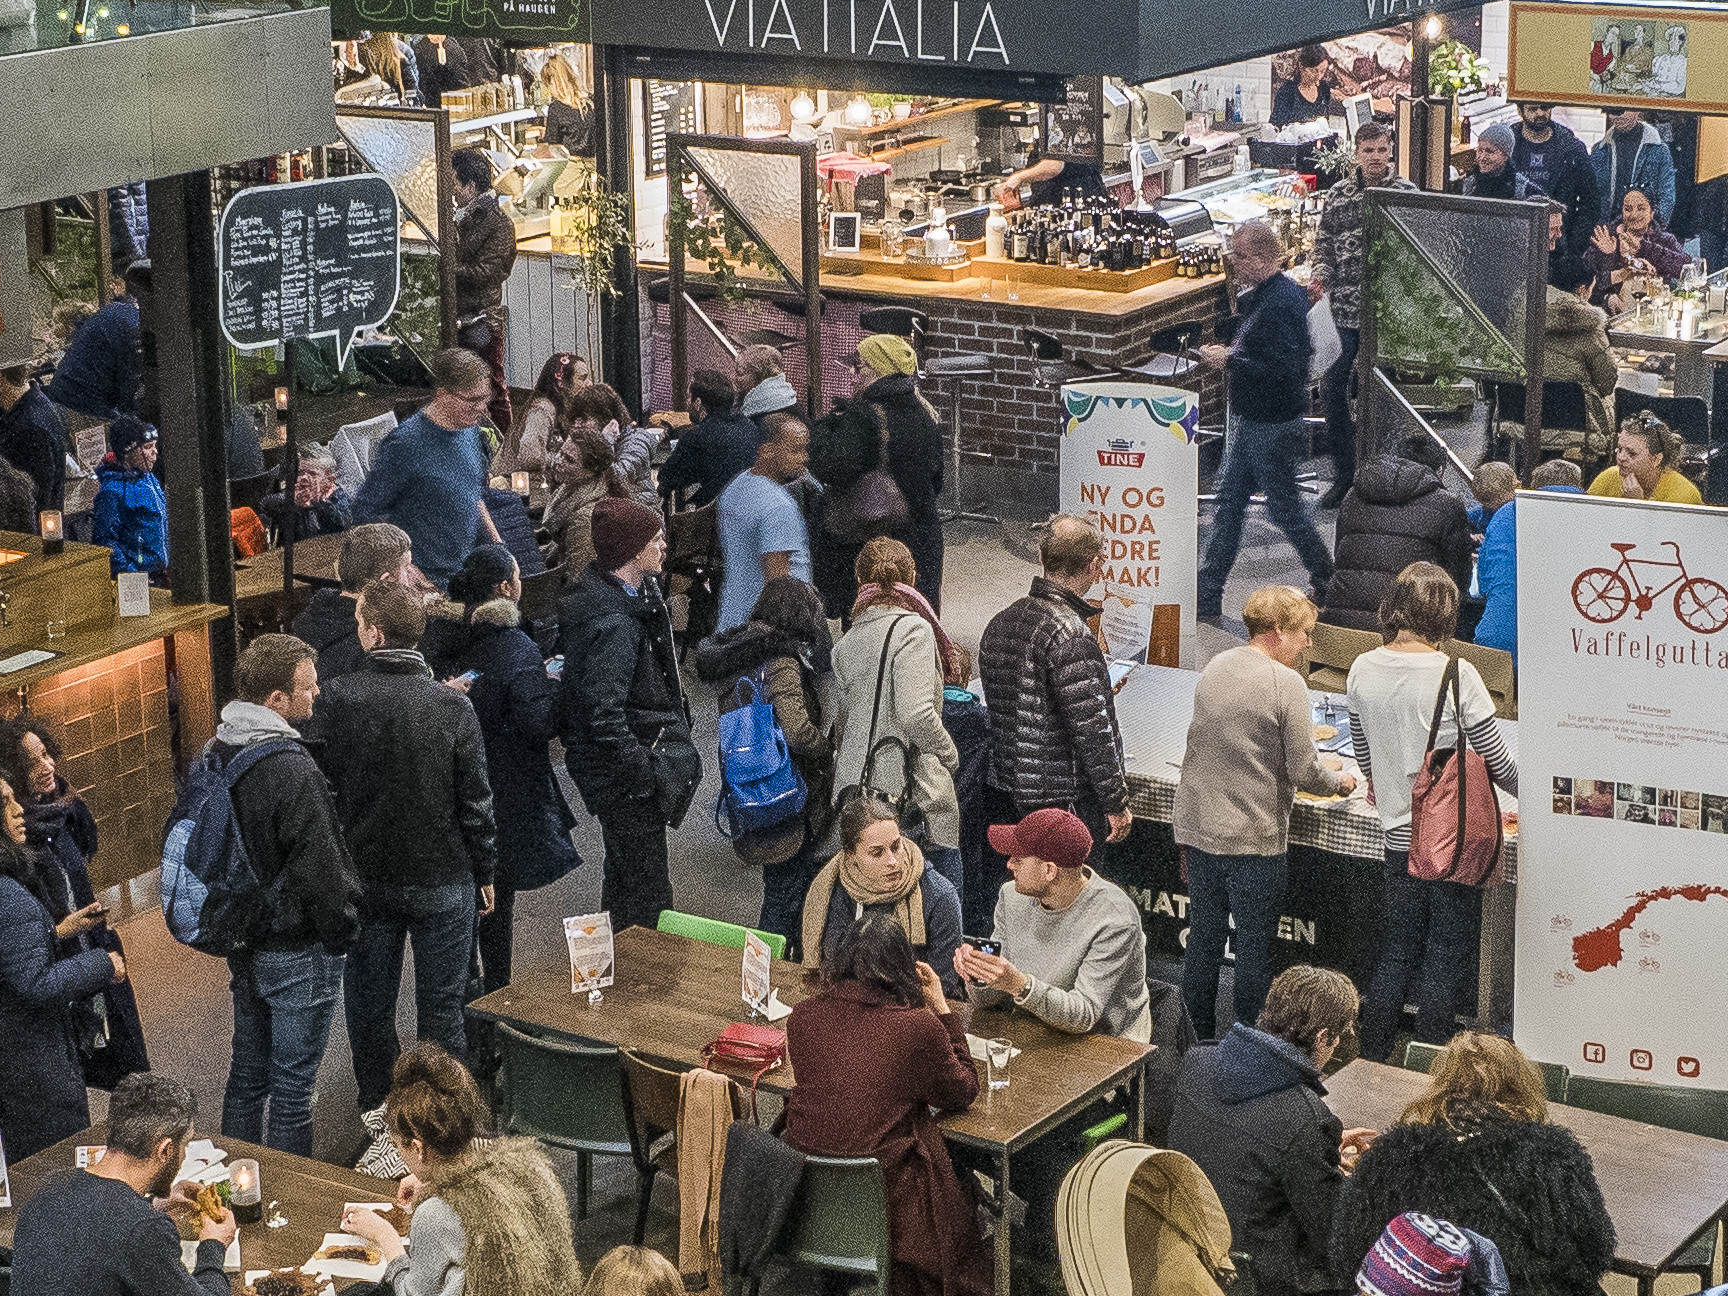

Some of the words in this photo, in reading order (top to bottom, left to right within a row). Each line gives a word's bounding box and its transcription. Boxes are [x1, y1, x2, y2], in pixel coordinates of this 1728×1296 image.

[1099, 450, 1144, 467] TINE
[1079, 481, 1115, 505] NY
[1121, 486, 1165, 508] OG
[1087, 508, 1160, 533] NDA
[1100, 537, 1162, 561] EDRE
[1100, 565, 1160, 586] MAK!
